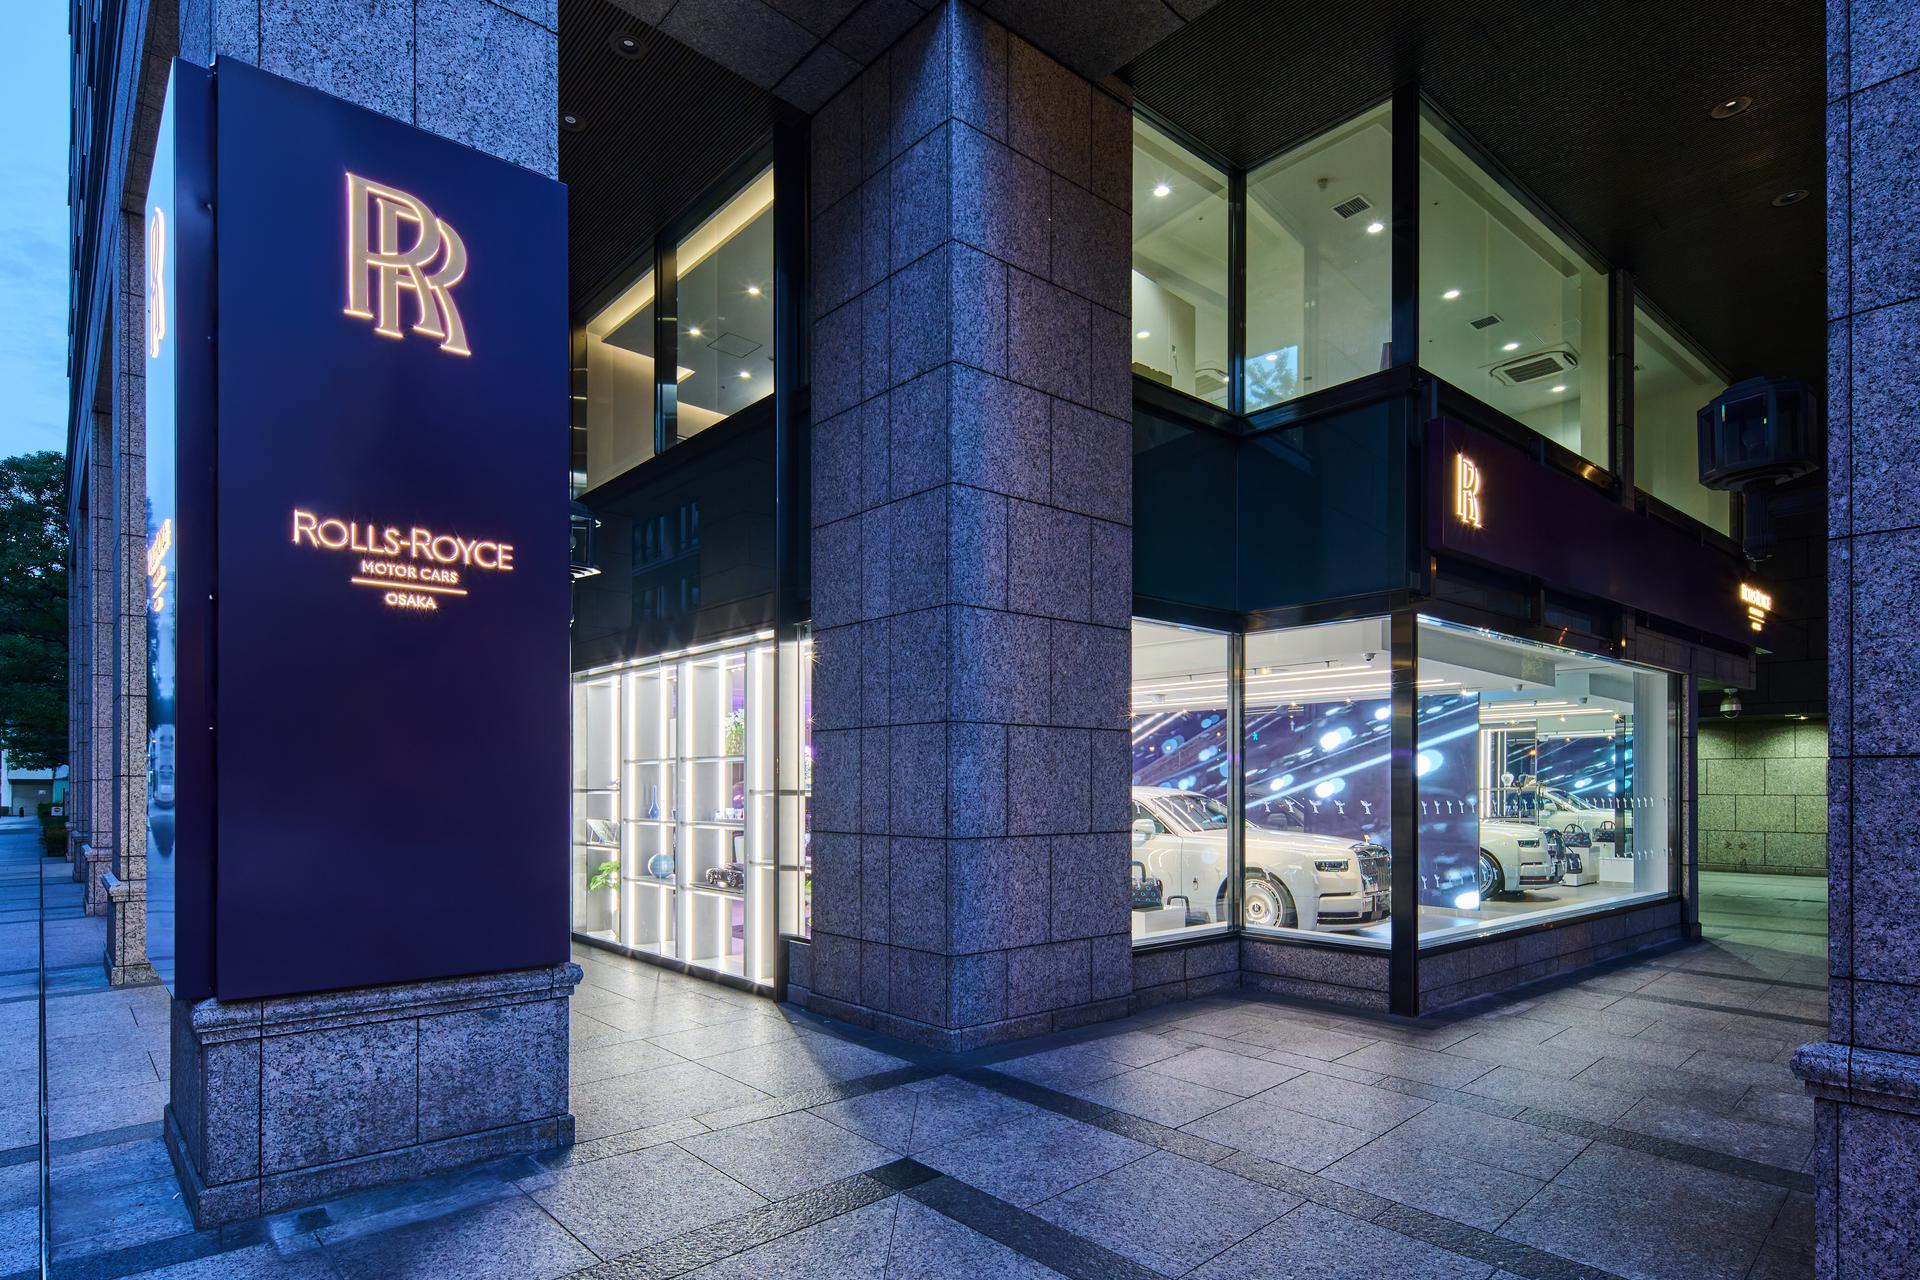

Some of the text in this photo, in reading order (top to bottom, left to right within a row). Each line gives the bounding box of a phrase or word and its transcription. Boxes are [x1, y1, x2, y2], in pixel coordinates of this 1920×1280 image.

[292, 509, 514, 570] ROLLS-ROYCE
[361, 560, 459, 584] MOTOR CARS
[385, 592, 437, 610] OSAKA
